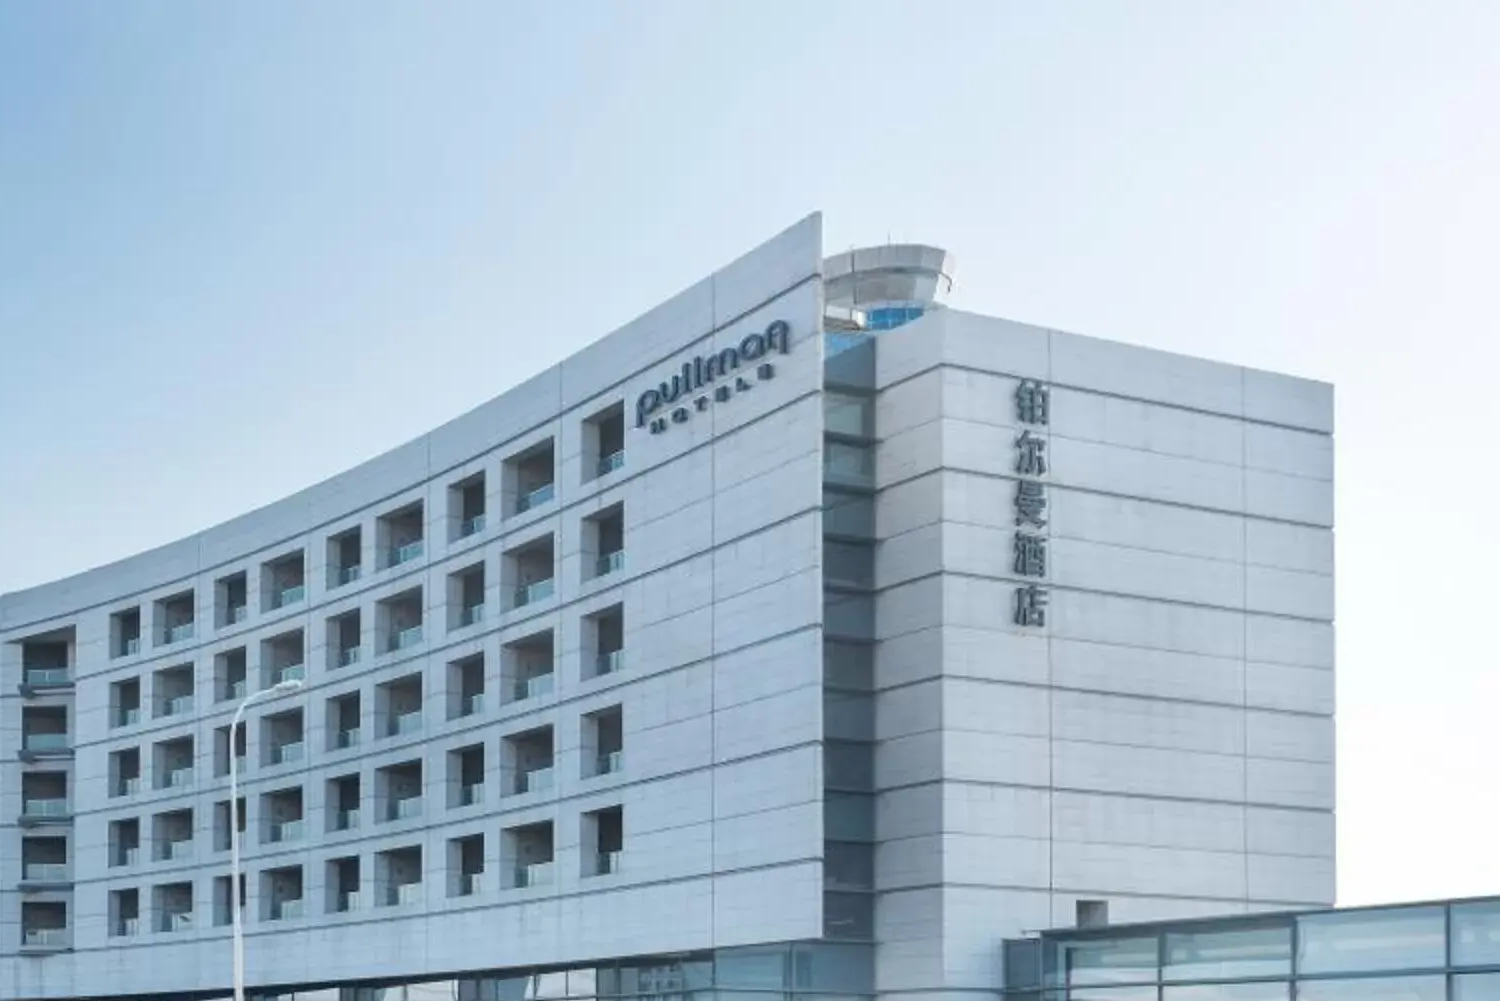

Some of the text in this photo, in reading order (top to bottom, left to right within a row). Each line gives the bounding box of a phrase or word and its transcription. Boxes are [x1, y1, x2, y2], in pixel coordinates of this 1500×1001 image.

[636, 319, 790, 428] pullman
[1013, 378, 1050, 628] 铂尔曼酒店
